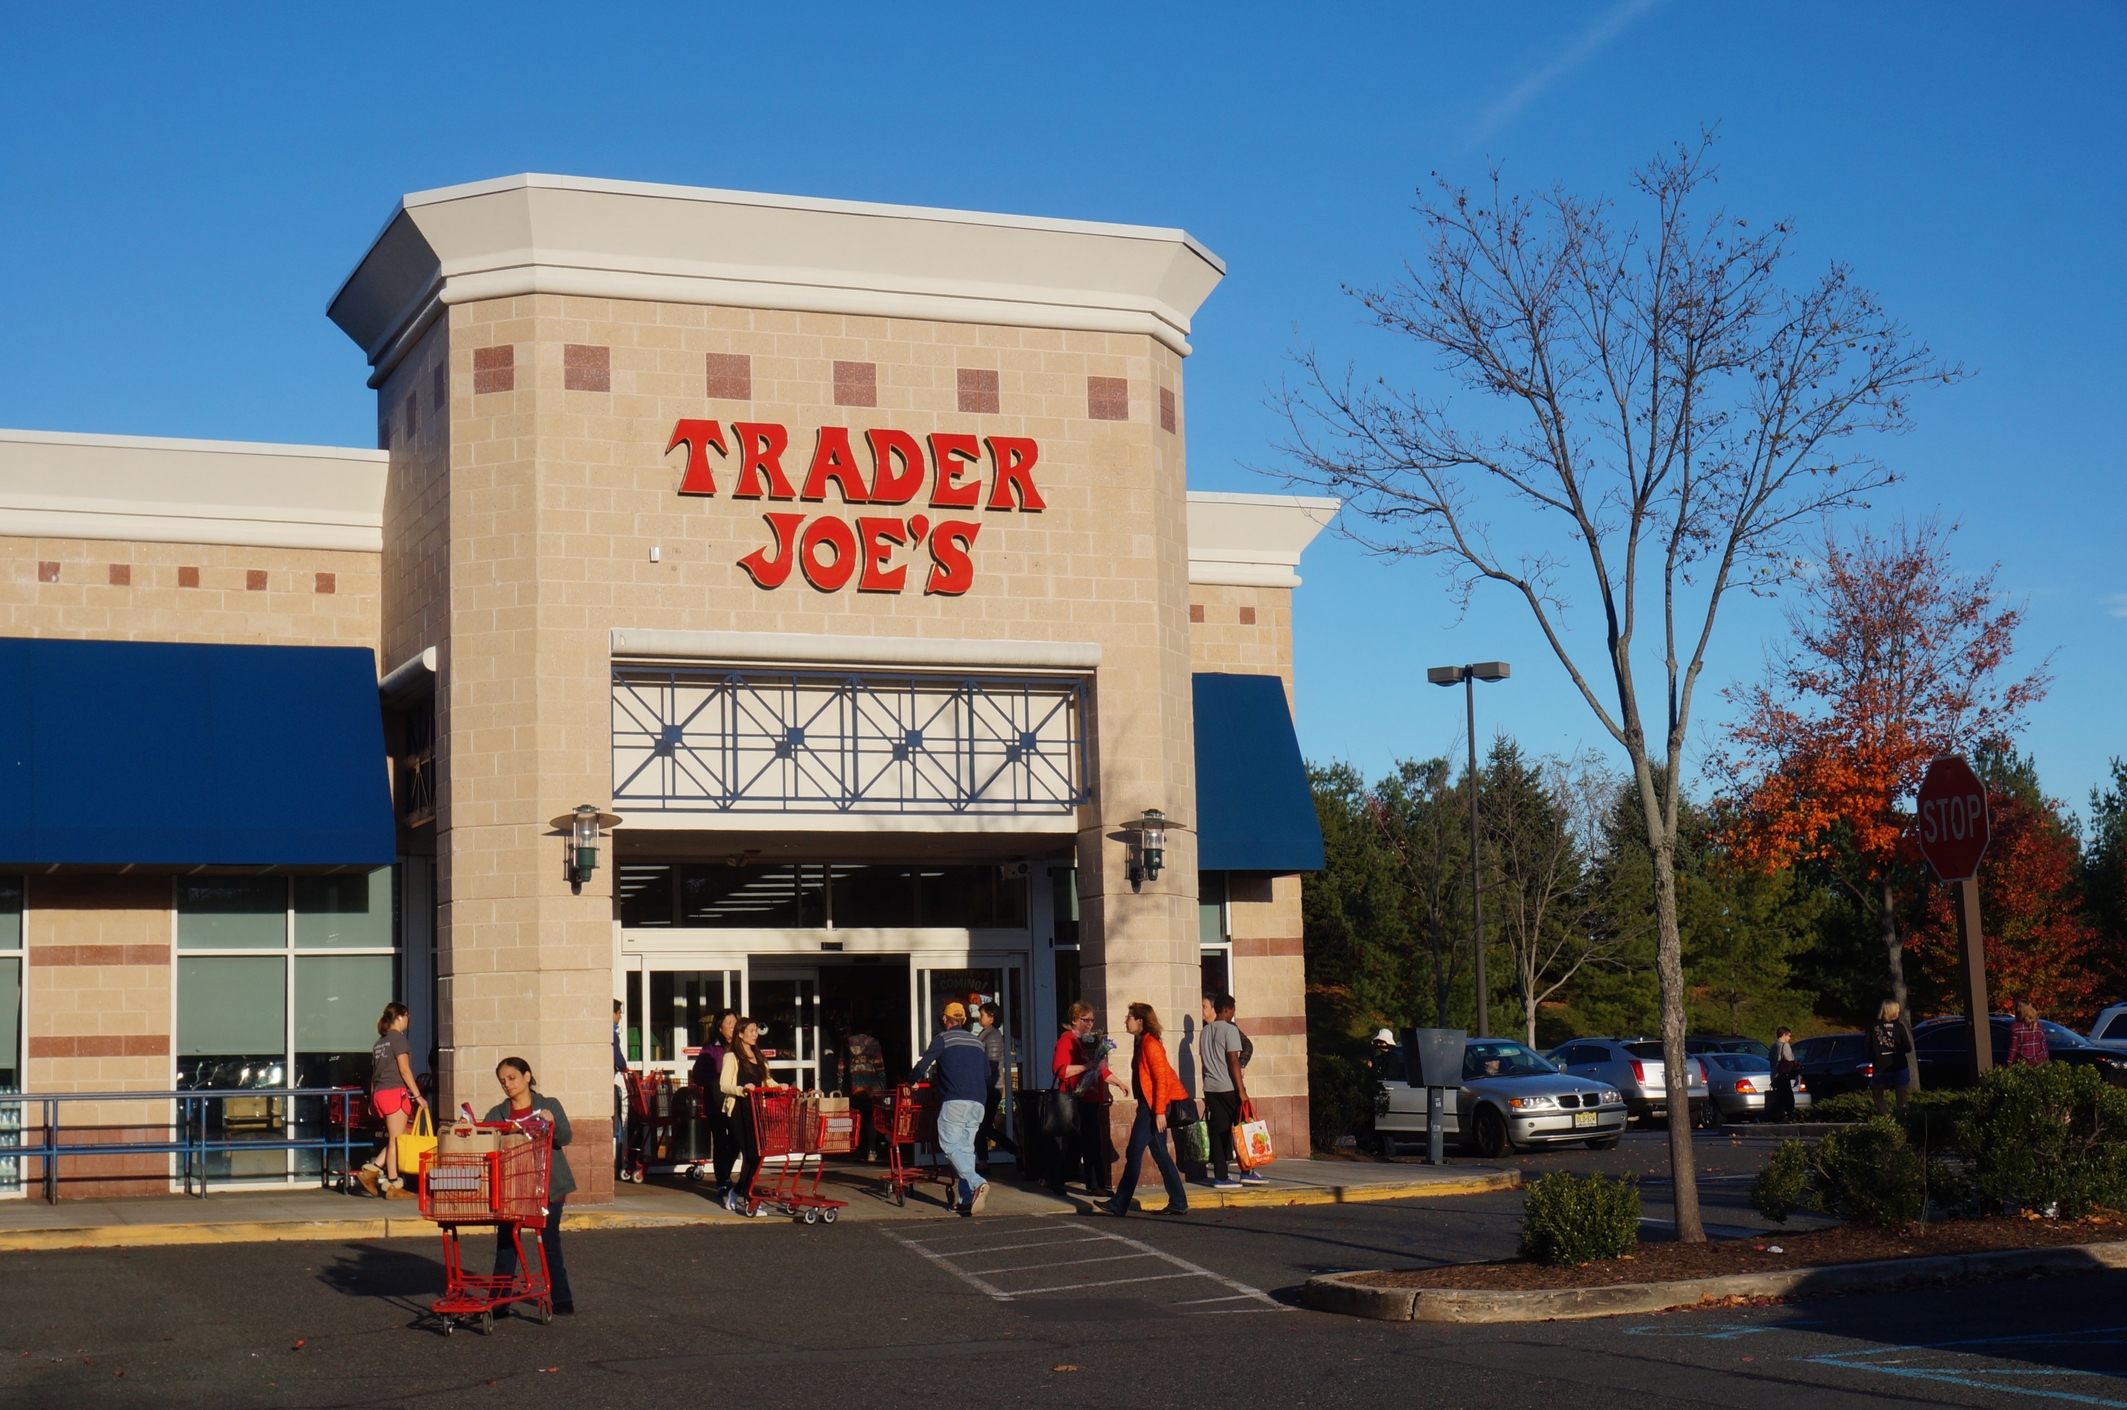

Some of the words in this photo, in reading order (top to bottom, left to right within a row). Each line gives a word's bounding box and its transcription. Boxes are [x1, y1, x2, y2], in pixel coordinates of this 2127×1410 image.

[665, 419, 1047, 512] TRADER
[736, 512, 982, 596] JOE'S
[1923, 794, 1981, 843] STOP
[940, 977, 988, 992] COMING!
